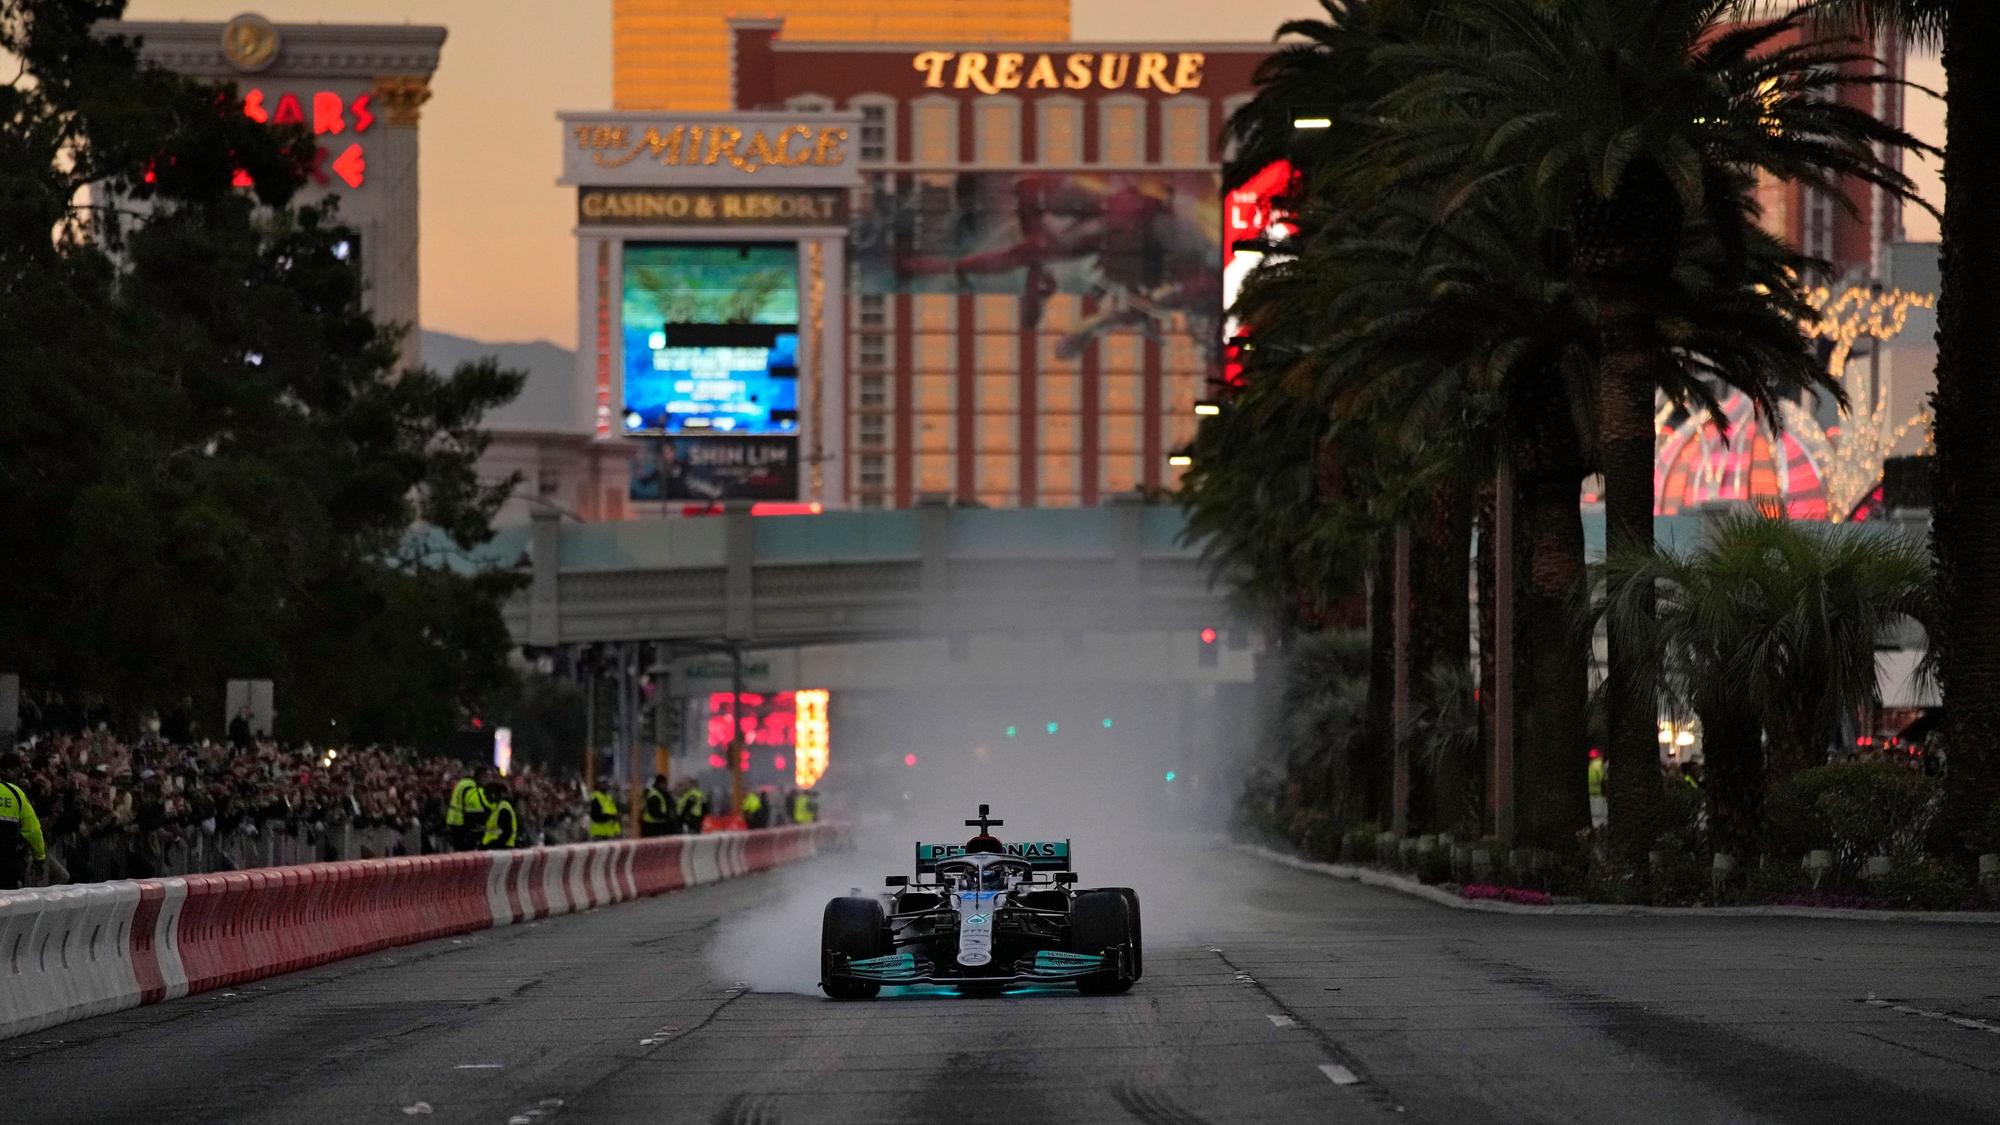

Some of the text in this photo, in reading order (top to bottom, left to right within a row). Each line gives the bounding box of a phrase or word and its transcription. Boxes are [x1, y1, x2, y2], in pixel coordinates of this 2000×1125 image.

[912, 51, 1205, 94] TREASURE
[593, 124, 848, 172] MIRAGE
[583, 191, 835, 218] CASINO & RESORT
